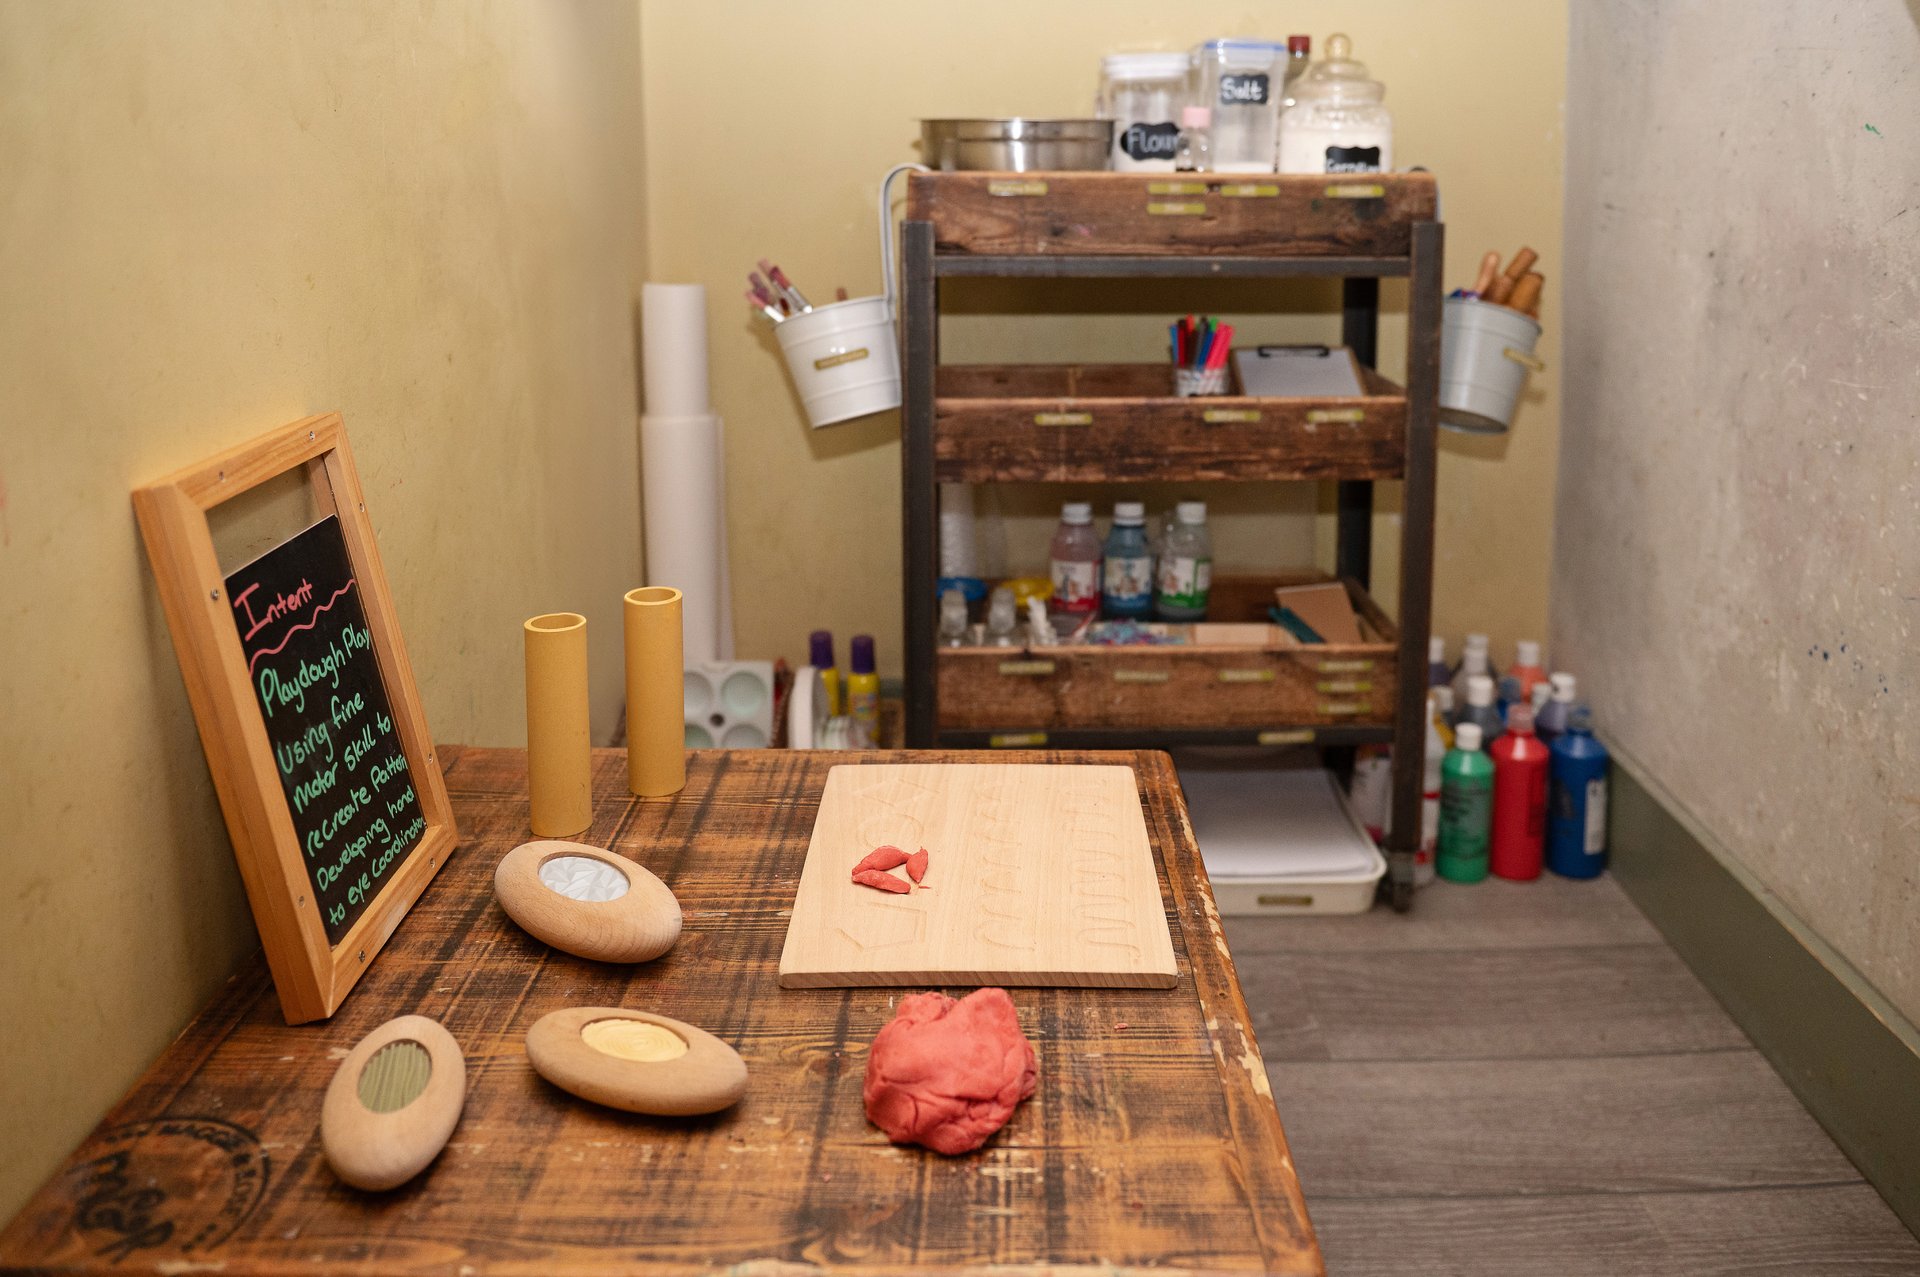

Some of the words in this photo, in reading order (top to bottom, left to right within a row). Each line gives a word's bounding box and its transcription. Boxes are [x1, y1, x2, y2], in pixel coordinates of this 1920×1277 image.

[1221, 78, 1263, 101] Salt
[233, 577, 313, 642] Intent
[259, 641, 346, 718] Playdough
[341, 622, 370, 659] Play
[276, 721, 334, 775] Using
[330, 692, 364, 730] fine
[376, 711, 391, 736] to
[316, 817, 392, 893] Developing
[386, 784, 415, 819] hand
[328, 902, 346, 926] to
[347, 872, 371, 904] eye
